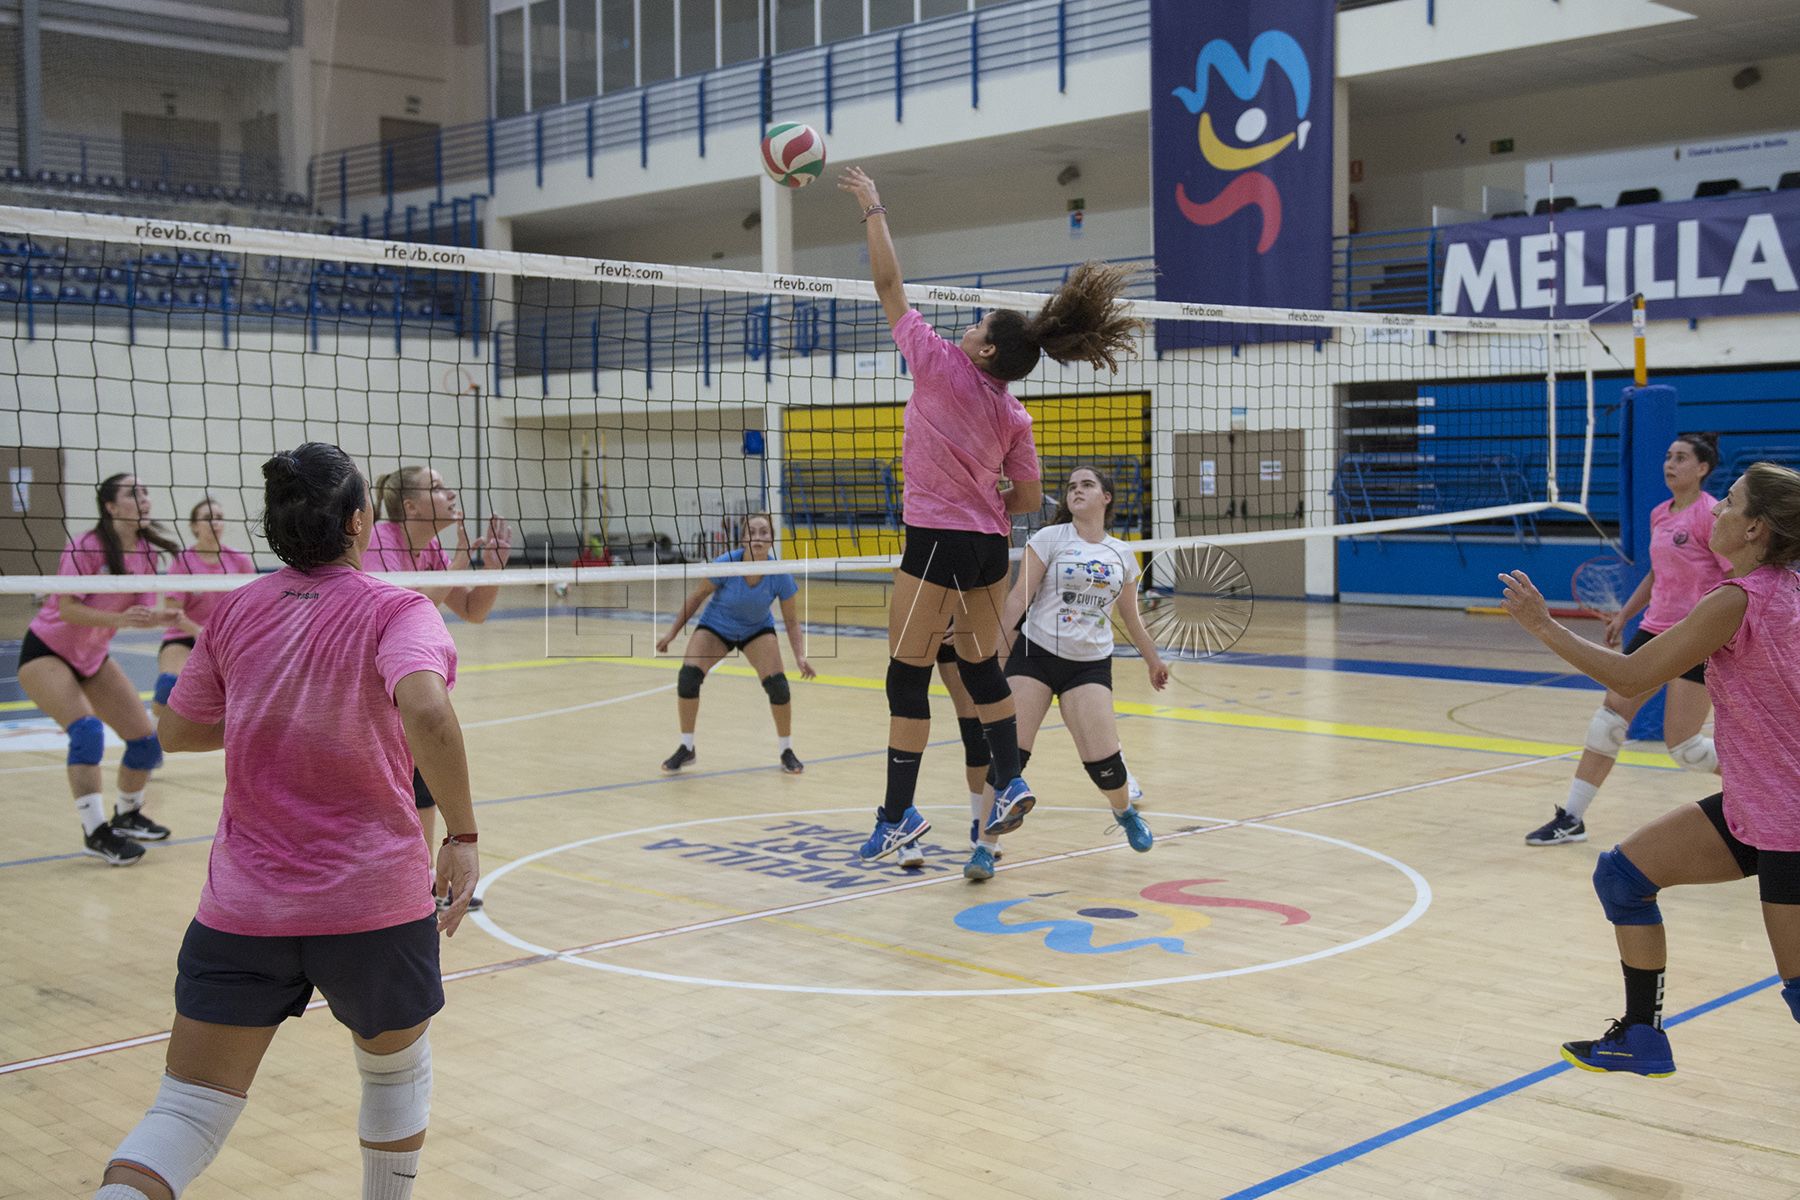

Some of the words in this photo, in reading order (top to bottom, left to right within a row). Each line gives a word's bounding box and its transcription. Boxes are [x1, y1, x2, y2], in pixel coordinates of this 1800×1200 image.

[135, 222, 232, 245] rfevb.com
[384, 244, 466, 264] rfevb.com
[594, 262, 663, 280] rfevb.com
[1441, 213, 1799, 315] MELILLA
[773, 276, 833, 292] rfevb.com
[928, 288, 981, 303] rfevb.com
[1182, 305, 1224, 317] rfevb.com
[1288, 311, 1325, 322] rfevb.com
[642, 838, 892, 889] MELILLA
[730, 837, 951, 877] SPORT
